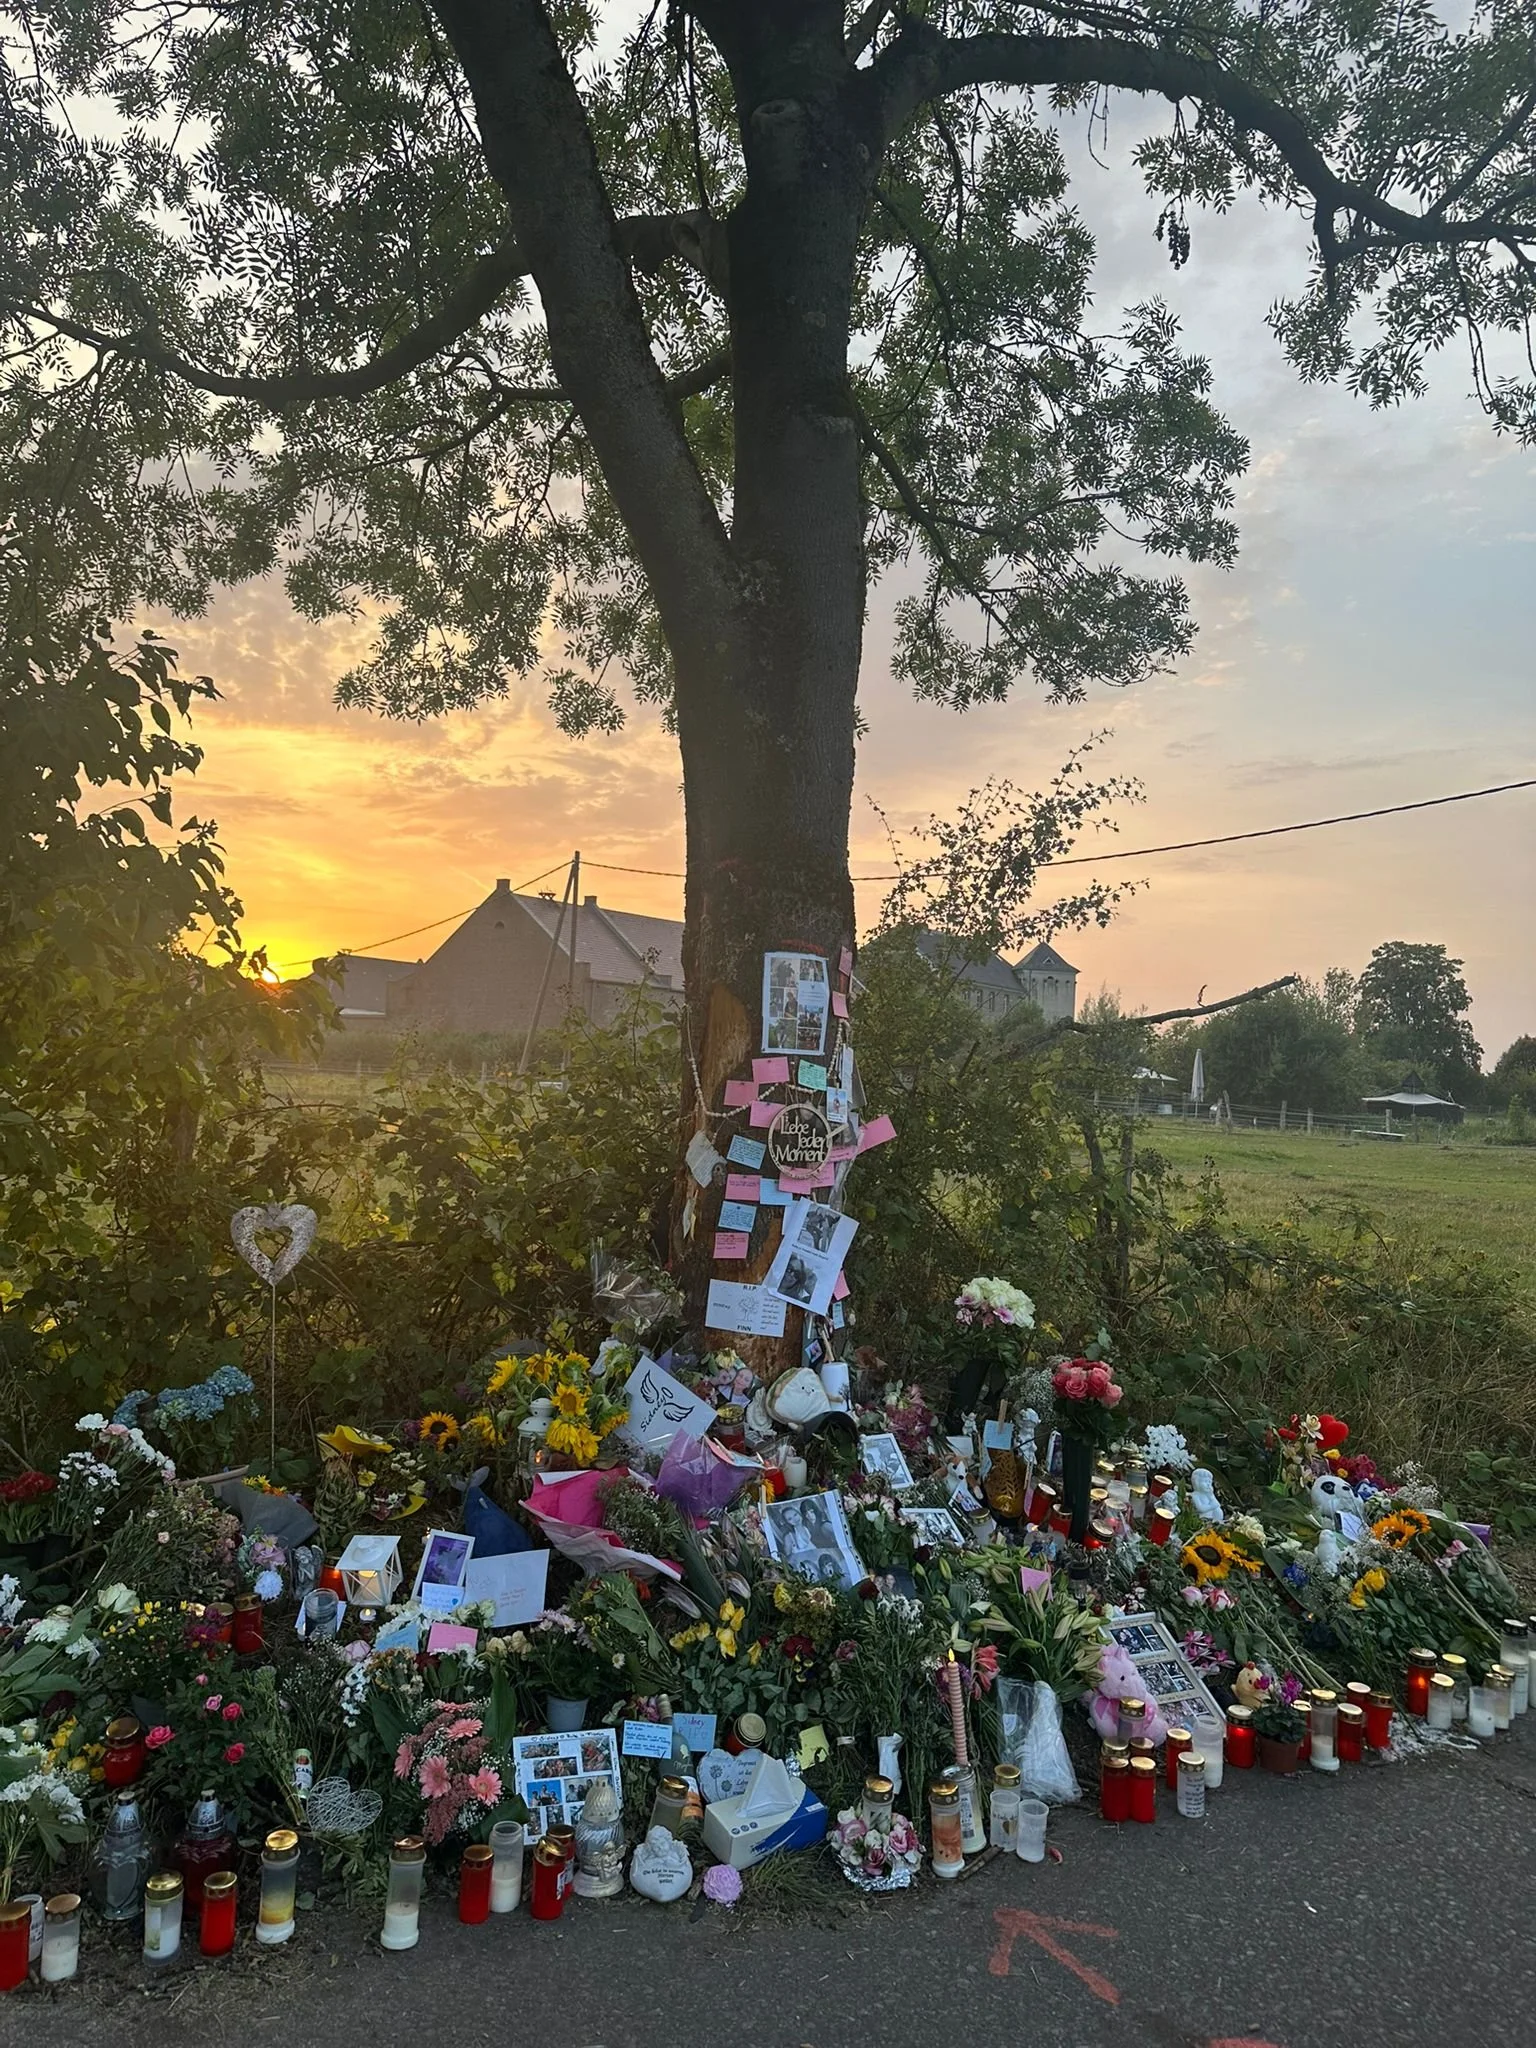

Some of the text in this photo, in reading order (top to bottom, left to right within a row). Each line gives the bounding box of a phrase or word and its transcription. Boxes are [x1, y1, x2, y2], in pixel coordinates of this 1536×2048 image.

[780, 1116, 809, 1135] Liebe
[797, 1128, 829, 1151] Jeden
[775, 1144, 825, 1163] Moment
[737, 1324, 752, 1332] FINN
[640, 1394, 667, 1432] Sidney
